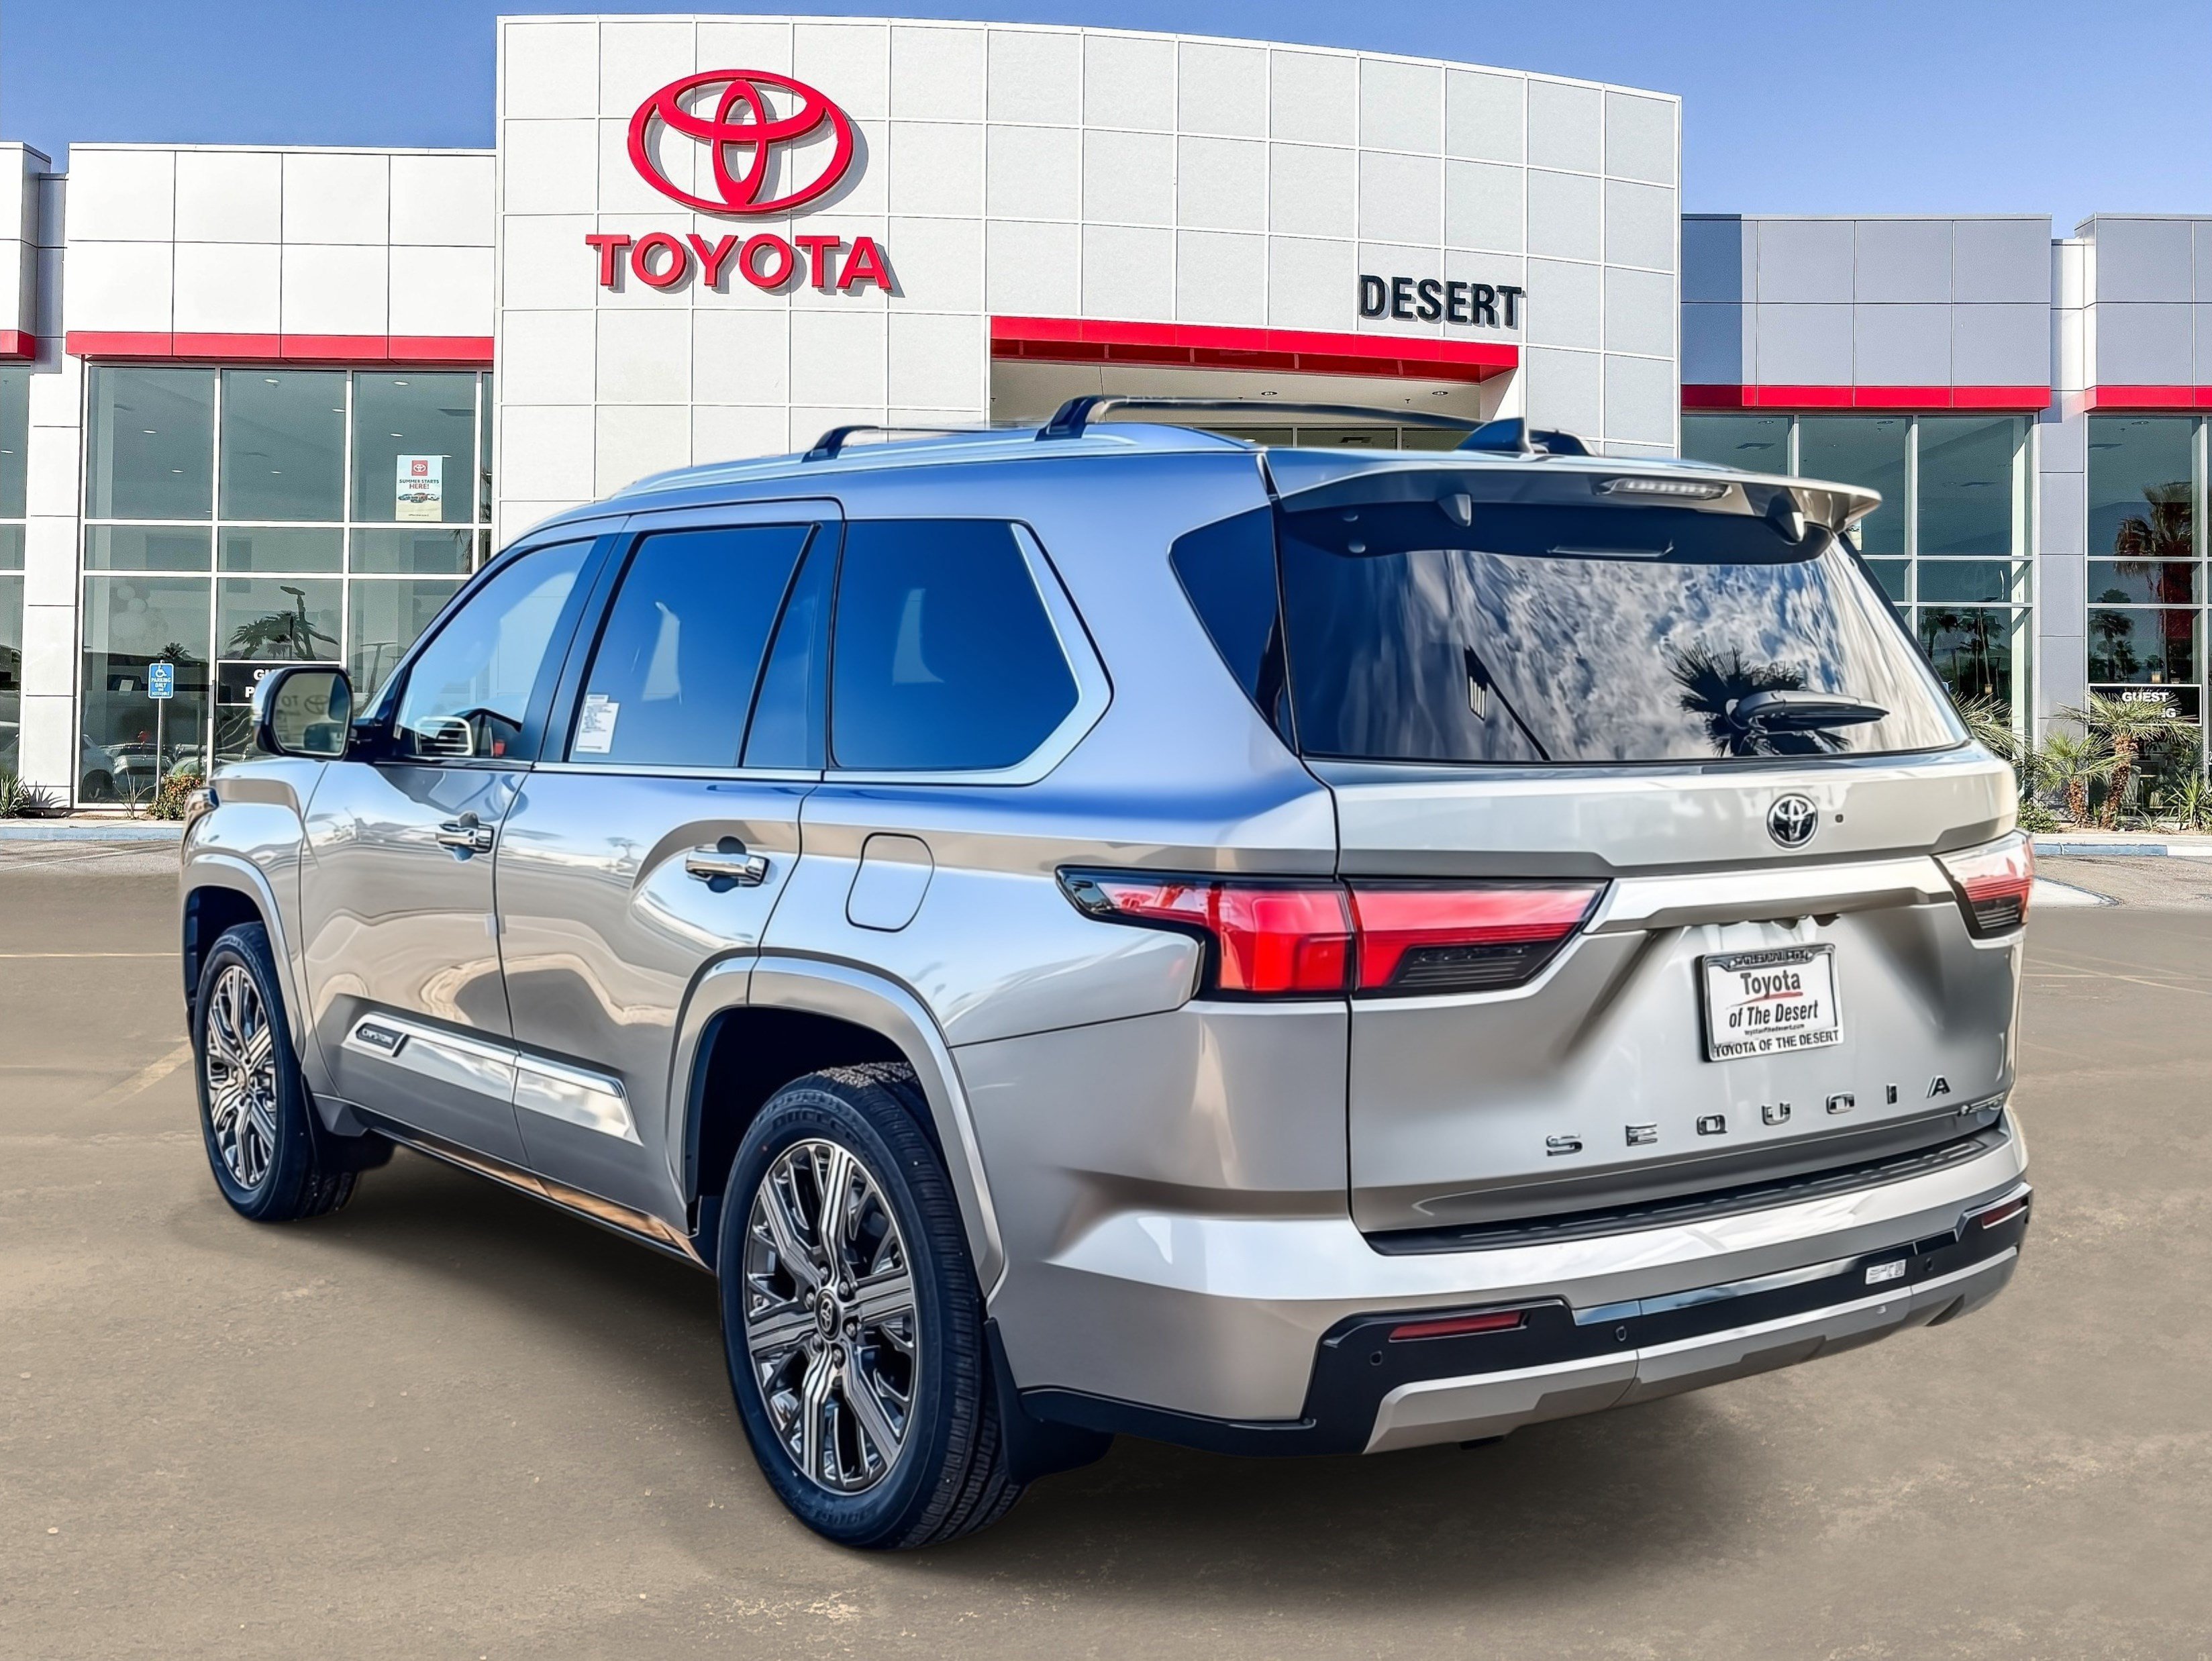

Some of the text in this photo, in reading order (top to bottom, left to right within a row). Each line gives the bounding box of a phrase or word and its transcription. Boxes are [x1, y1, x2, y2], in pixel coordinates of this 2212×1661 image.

[585, 232, 893, 291] TOYOTA
[1359, 274, 1522, 326] DESERT
[2122, 692, 2169, 702] GUEST
[1740, 970, 1801, 998] Toyota
[1729, 999, 1819, 1027] of The Desert
[1715, 1029, 1839, 1057] TOYOTA OF THE DESERT
[1546, 1074, 1951, 1157] SEQUOIA
